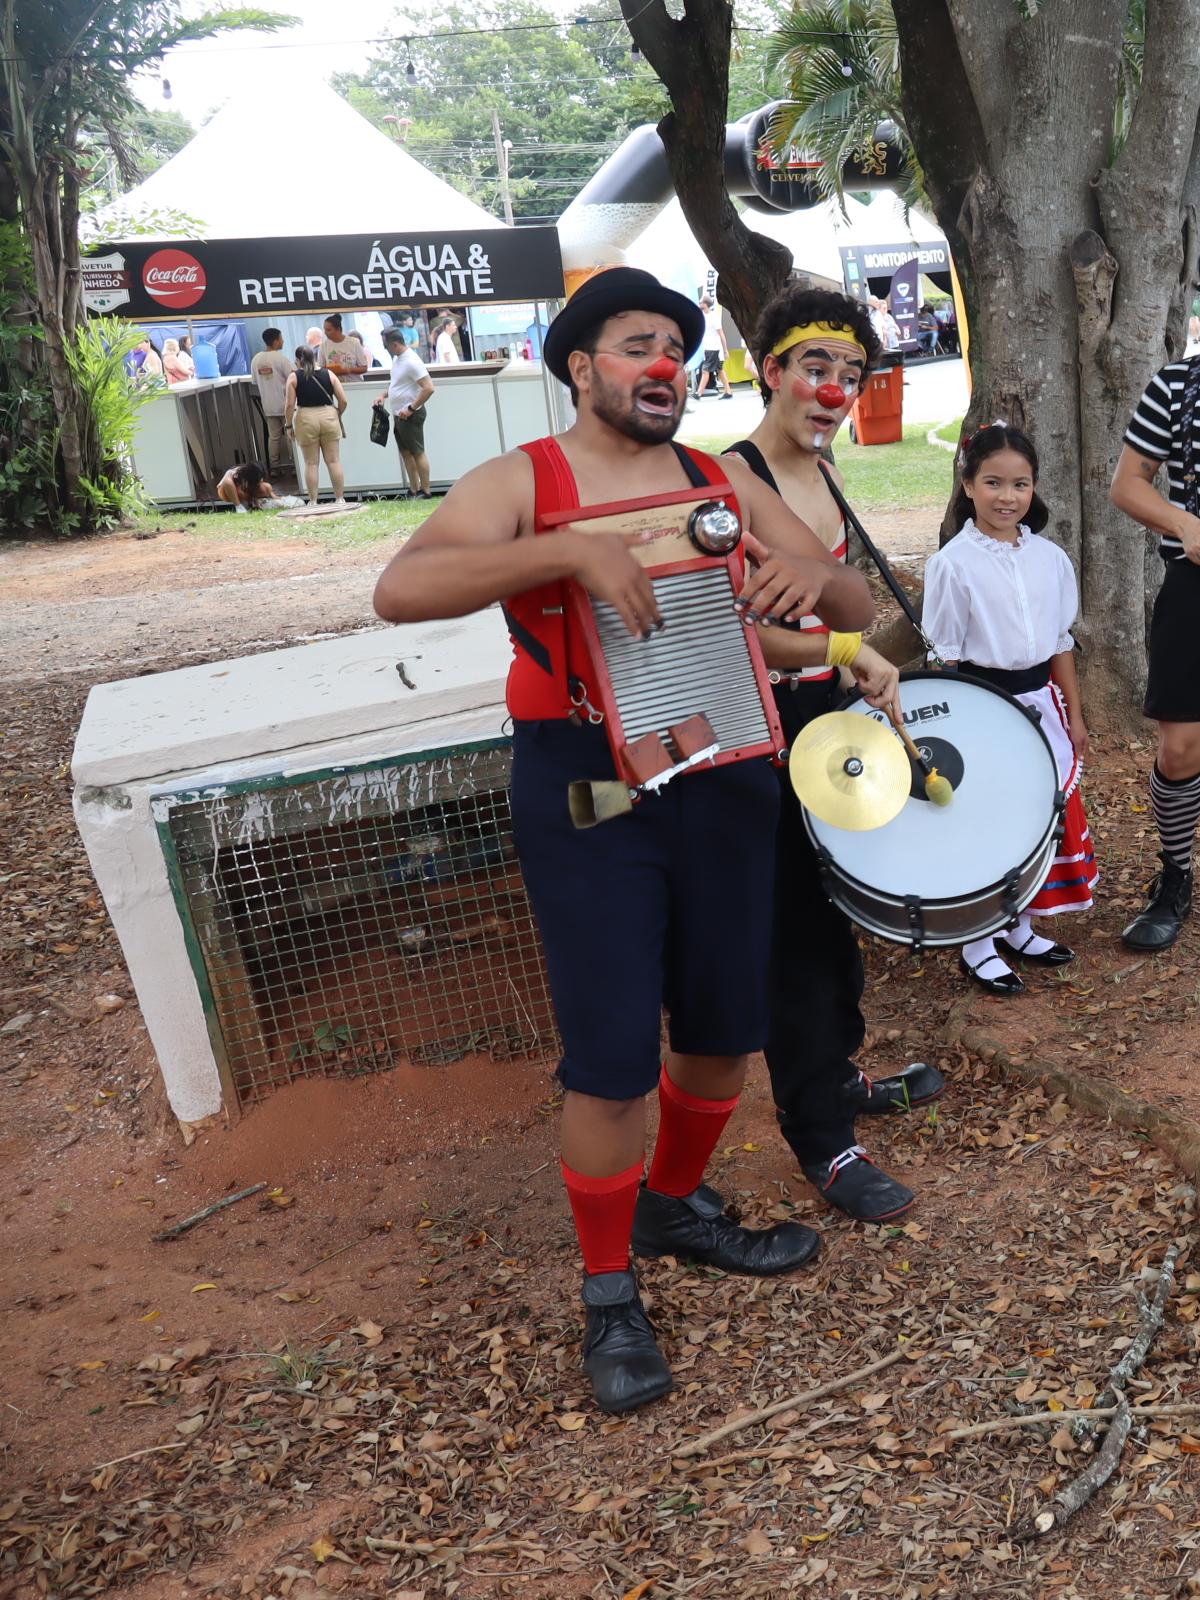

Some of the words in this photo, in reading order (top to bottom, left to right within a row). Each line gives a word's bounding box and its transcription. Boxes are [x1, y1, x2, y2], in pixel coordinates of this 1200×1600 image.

[367, 240, 462, 272] ÁGUA
[467, 243, 491, 268] &
[864, 249, 945, 268] MONITORAMENTO
[84, 279, 120, 288] NHEDO
[146, 266, 199, 284] Coca-Cola
[239, 269, 494, 305] REFRIGERANTE
[901, 701, 951, 725] UEN
